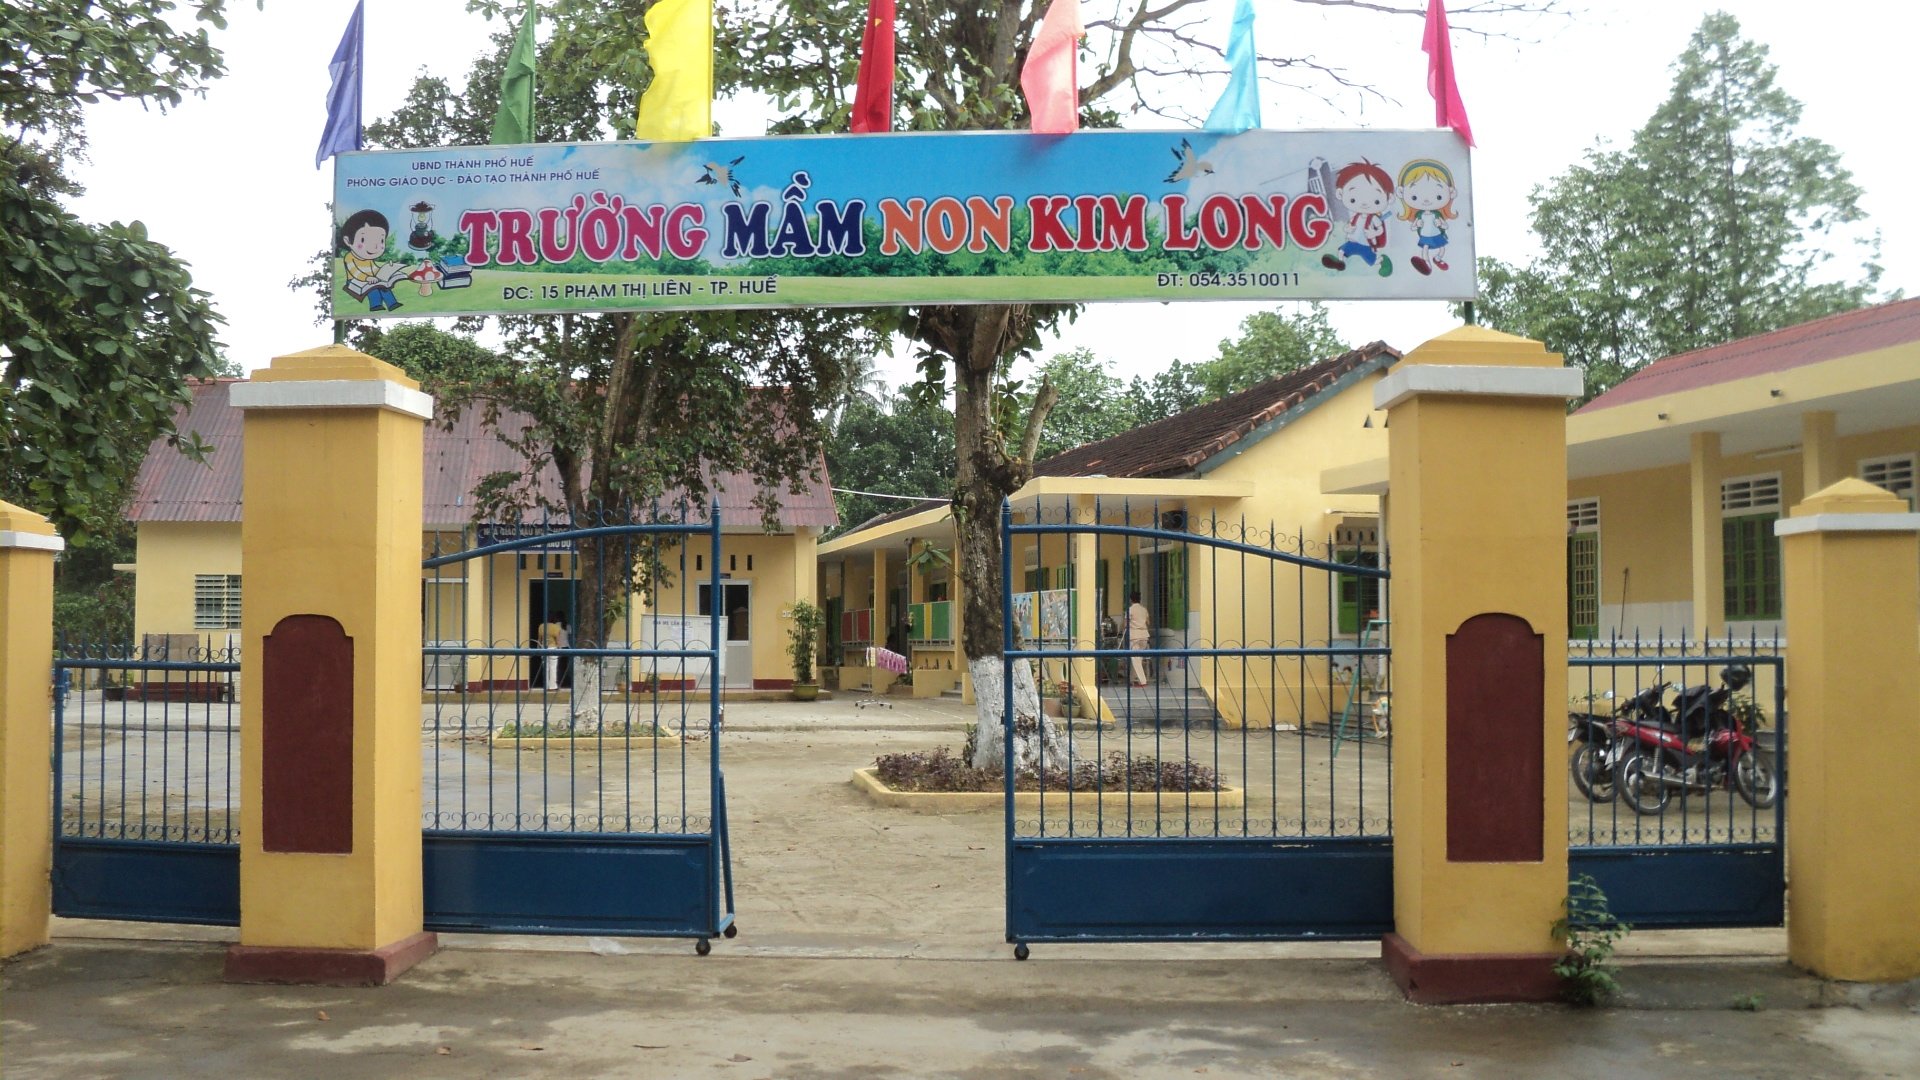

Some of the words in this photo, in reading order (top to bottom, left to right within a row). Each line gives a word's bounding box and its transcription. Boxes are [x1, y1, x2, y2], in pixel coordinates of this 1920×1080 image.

[411, 161, 442, 171] UBND
[444, 158, 481, 170] THÀNH
[484, 156, 507, 168] PHỐ
[510, 155, 534, 167] HUẾ
[347, 176, 386, 188] PHÒNG
[389, 175, 418, 187] GIÁO
[421, 176, 446, 187] DỤC
[457, 173, 482, 185] ĐÀO
[485, 174, 507, 185] TẠO
[509, 171, 547, 183] THÀNH
[549, 169, 573, 181] PHỐ
[576, 168, 600, 180] HUẾ
[458, 191, 708, 266] TRƯỜNG
[720, 171, 866, 259] MẦM
[878, 194, 1015, 255] NON
[1028, 194, 1149, 252] KIM
[1161, 193, 1332, 252] LONG
[503, 287, 533, 300] ĐC:
[541, 285, 558, 299] 15
[564, 284, 616, 301] PHẠM
[622, 283, 646, 299] THỊ
[652, 279, 691, 297] LIÊN
[710, 281, 733, 295] TP.
[739, 274, 779, 294] HUẾ
[1157, 273, 1183, 287] ĐT:
[1189, 273, 1299, 287] 054.3510011
